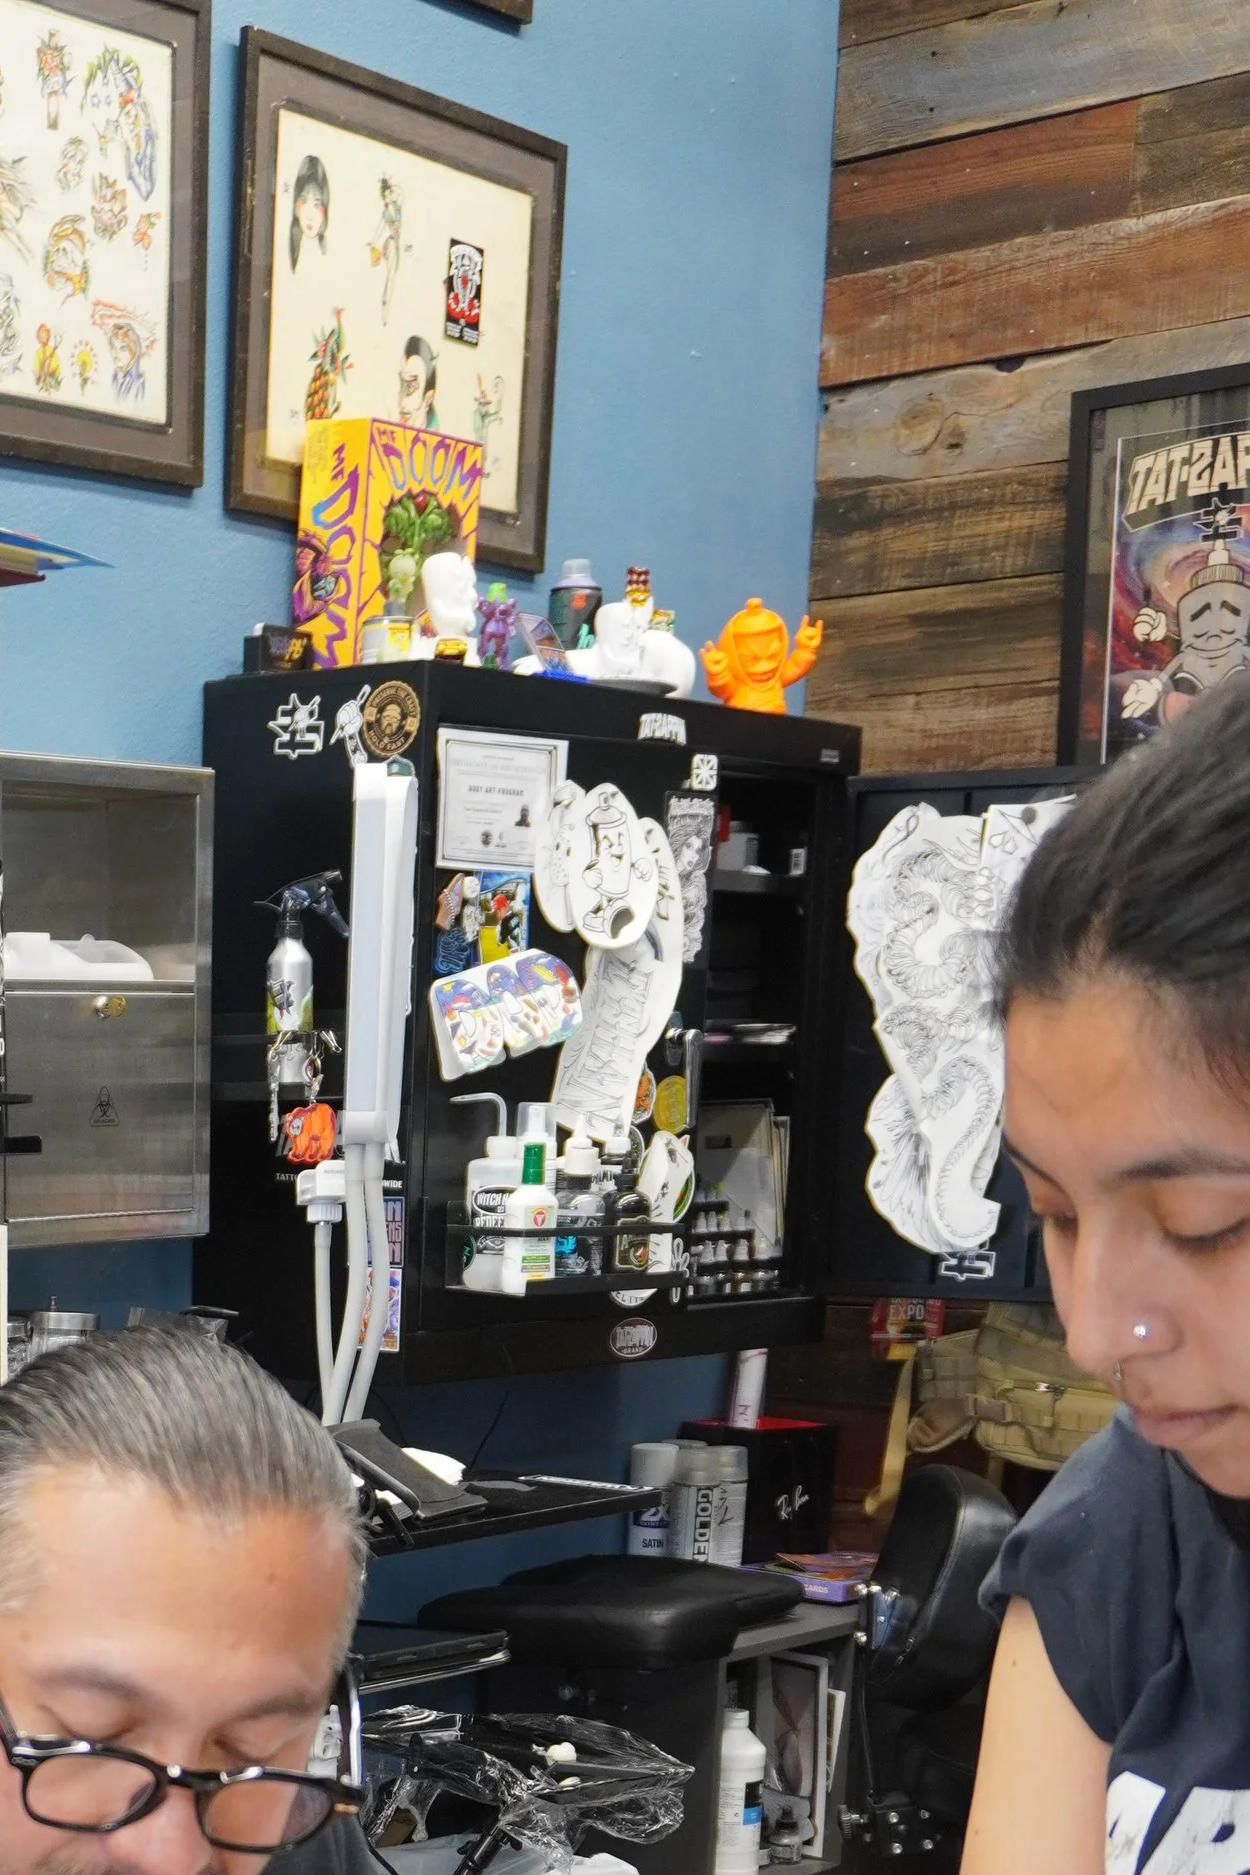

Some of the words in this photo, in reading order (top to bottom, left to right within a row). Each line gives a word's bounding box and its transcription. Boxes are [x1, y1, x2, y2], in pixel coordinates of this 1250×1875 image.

[381, 431, 485, 503] DOOM
[368, 729, 385, 750] HOLD
[386, 737, 405, 751] FAST
[476, 1192, 501, 1206] WITCH
[889, 1304, 925, 1320] EXPO
[642, 1538, 664, 1549] SATIN
